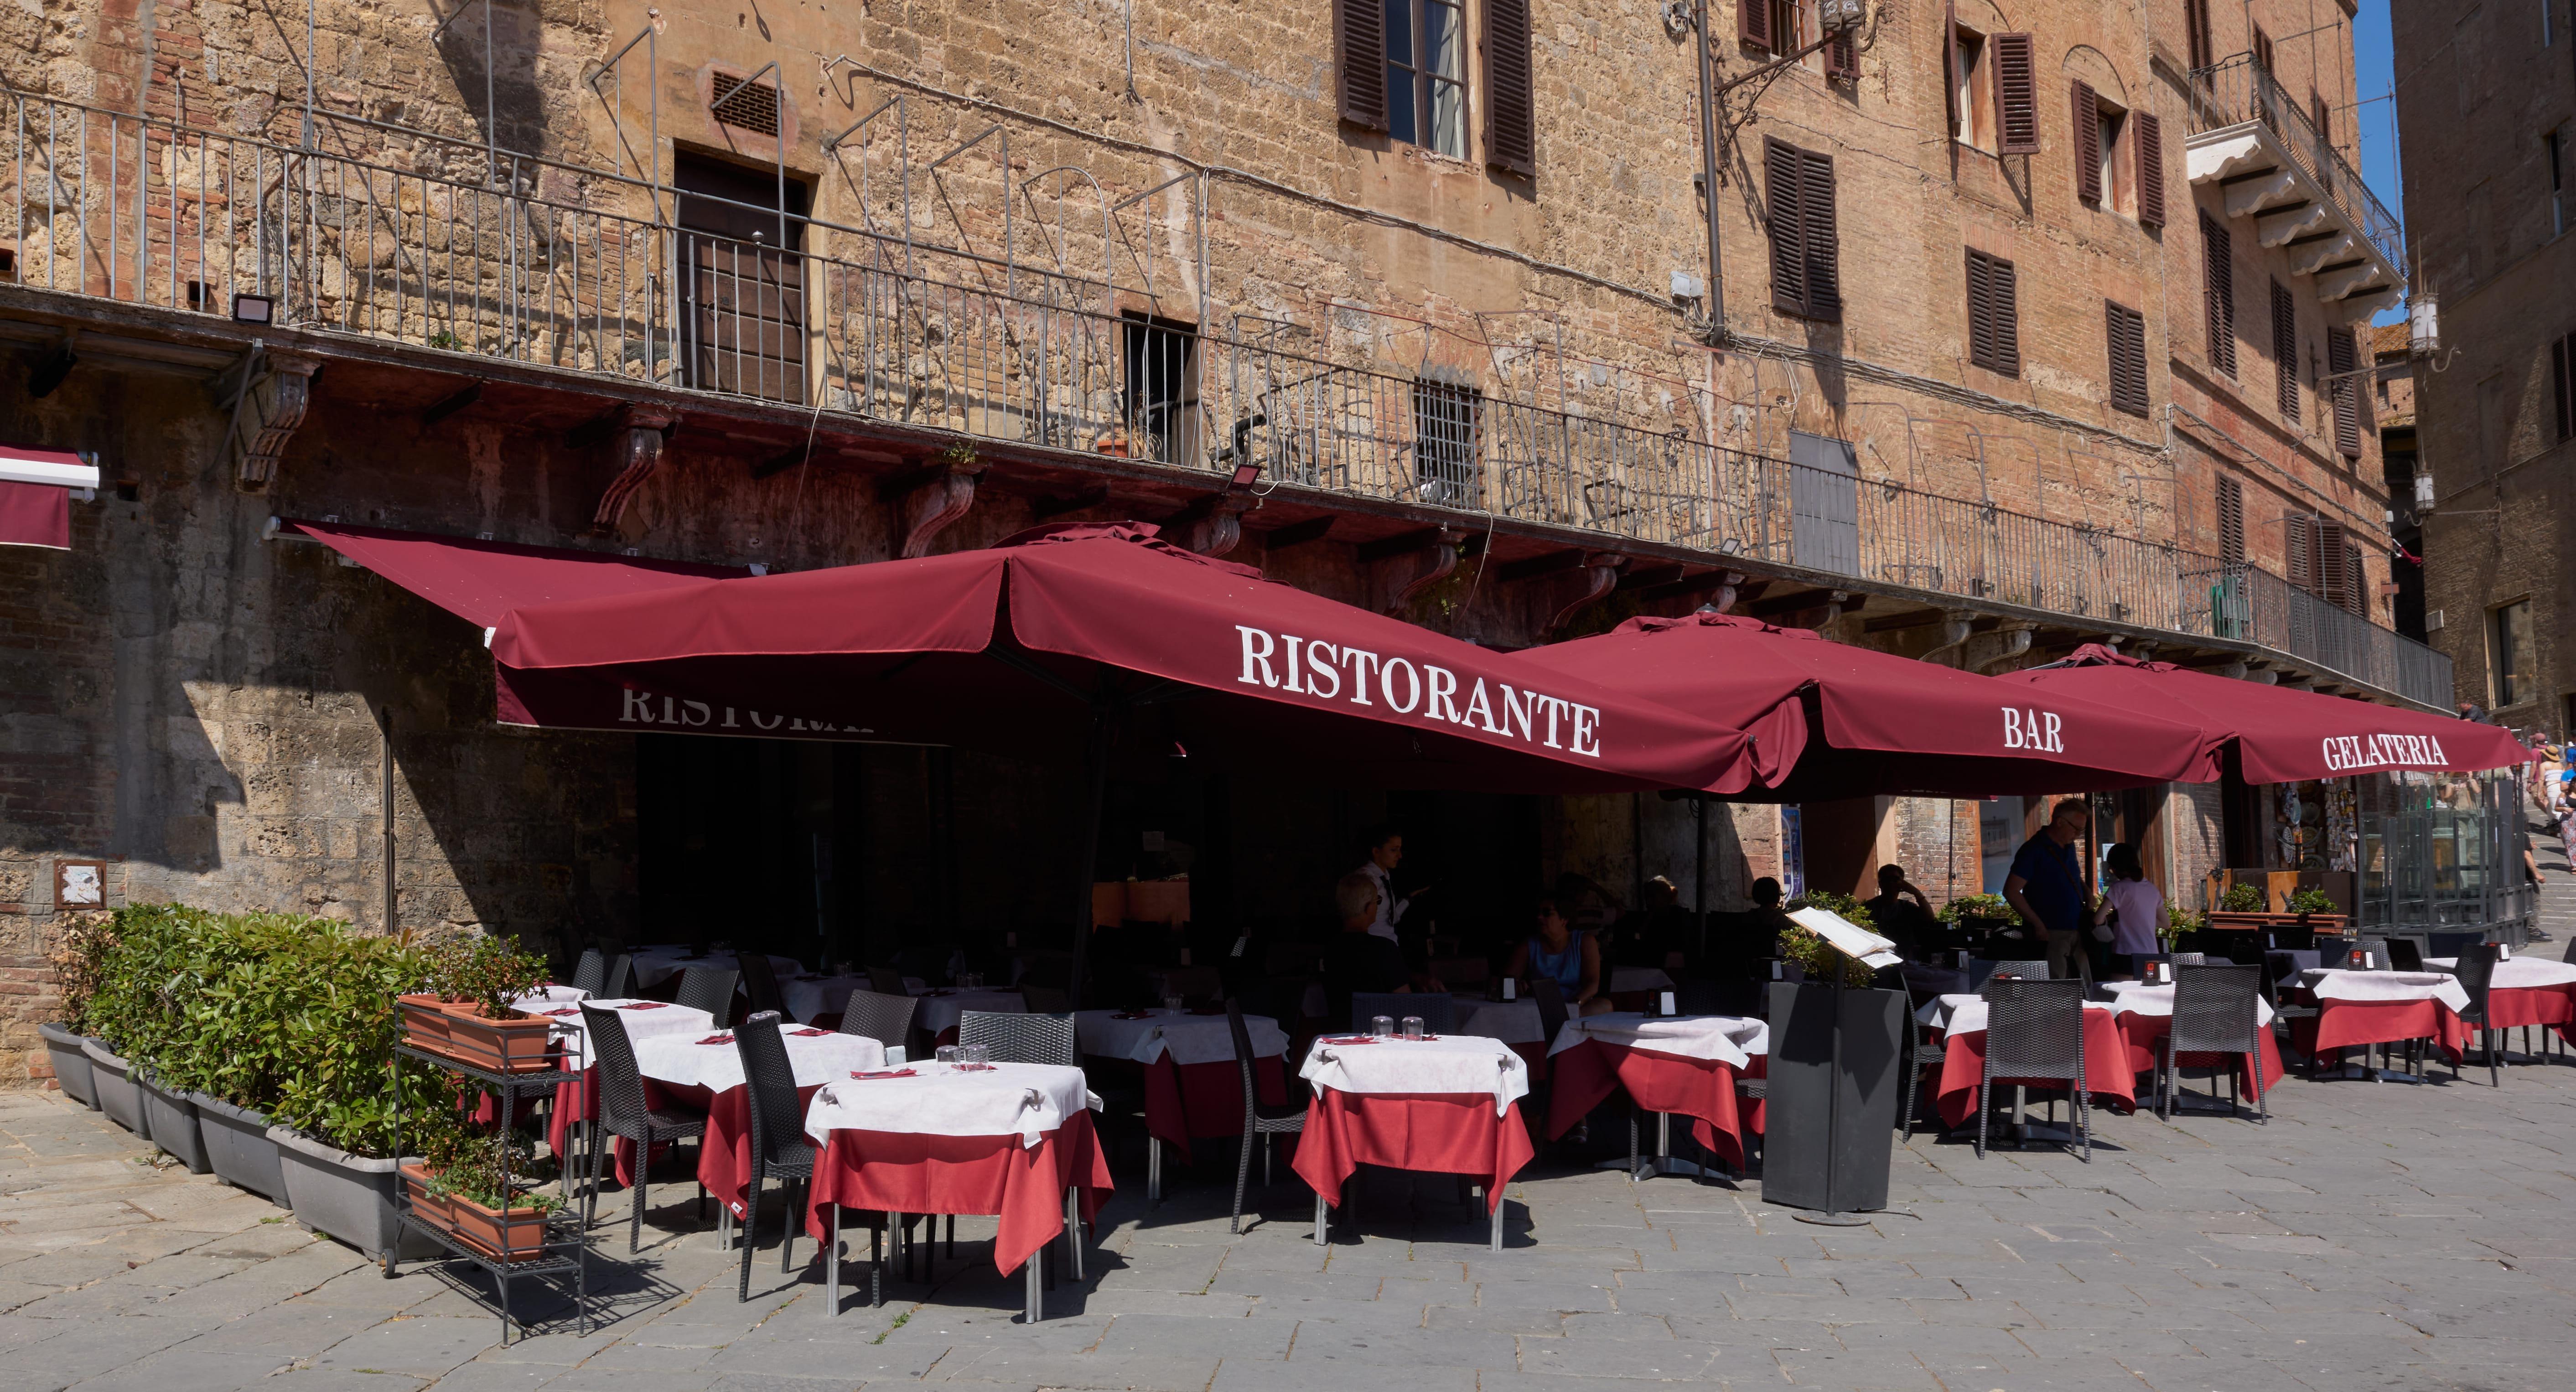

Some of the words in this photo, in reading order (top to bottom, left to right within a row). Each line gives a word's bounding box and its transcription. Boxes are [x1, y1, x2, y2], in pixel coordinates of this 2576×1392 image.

[1235, 625, 1600, 758] RISTORANTE
[2001, 707, 2064, 753] BAR
[2323, 734, 2449, 771] GELATERIA
